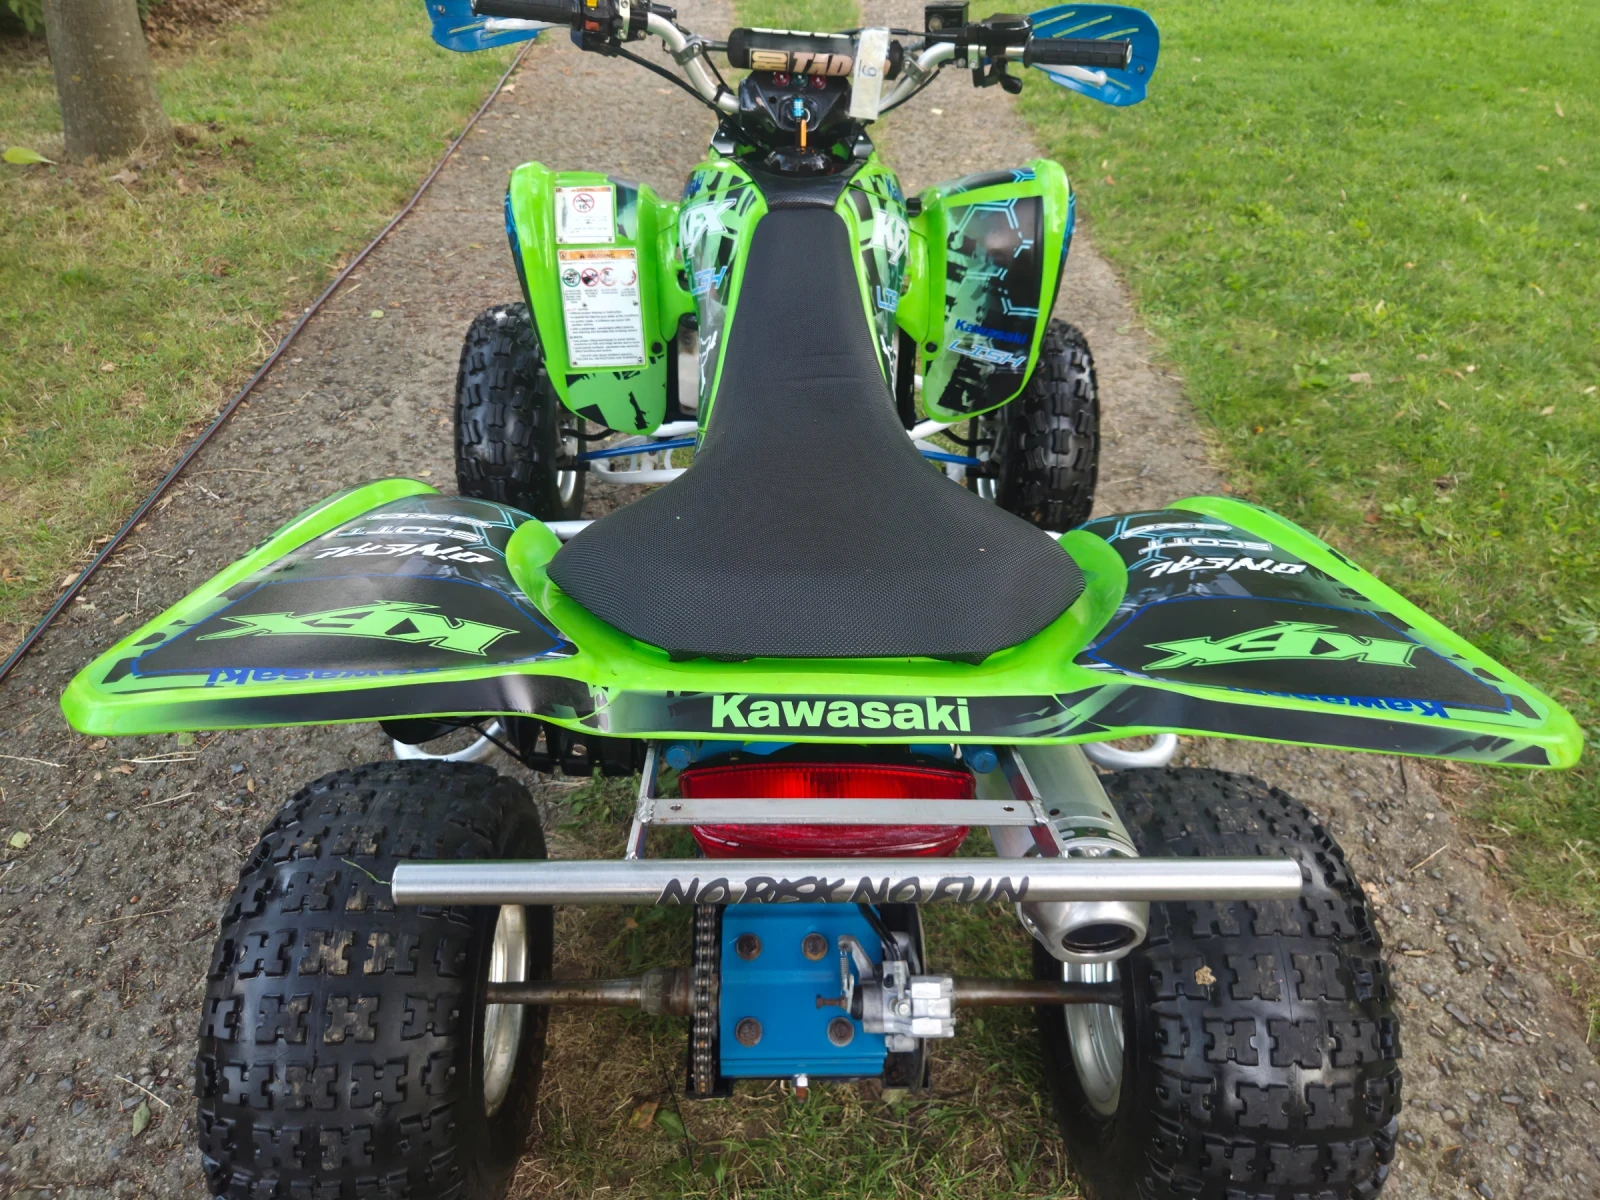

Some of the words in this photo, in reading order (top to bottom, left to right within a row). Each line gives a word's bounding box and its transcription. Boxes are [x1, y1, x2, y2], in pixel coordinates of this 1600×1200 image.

[954, 318, 1029, 344] Kawasaki
[334, 526, 485, 543] SCOTT
[1138, 537, 1272, 555] SCOTT
[196, 600, 520, 656] KFX
[1142, 620, 1428, 670] KFX
[711, 694, 971, 732] Kawasaki
[656, 876, 731, 904] NO
[848, 876, 922, 904] NO
[924, 876, 1029, 904] FUN
